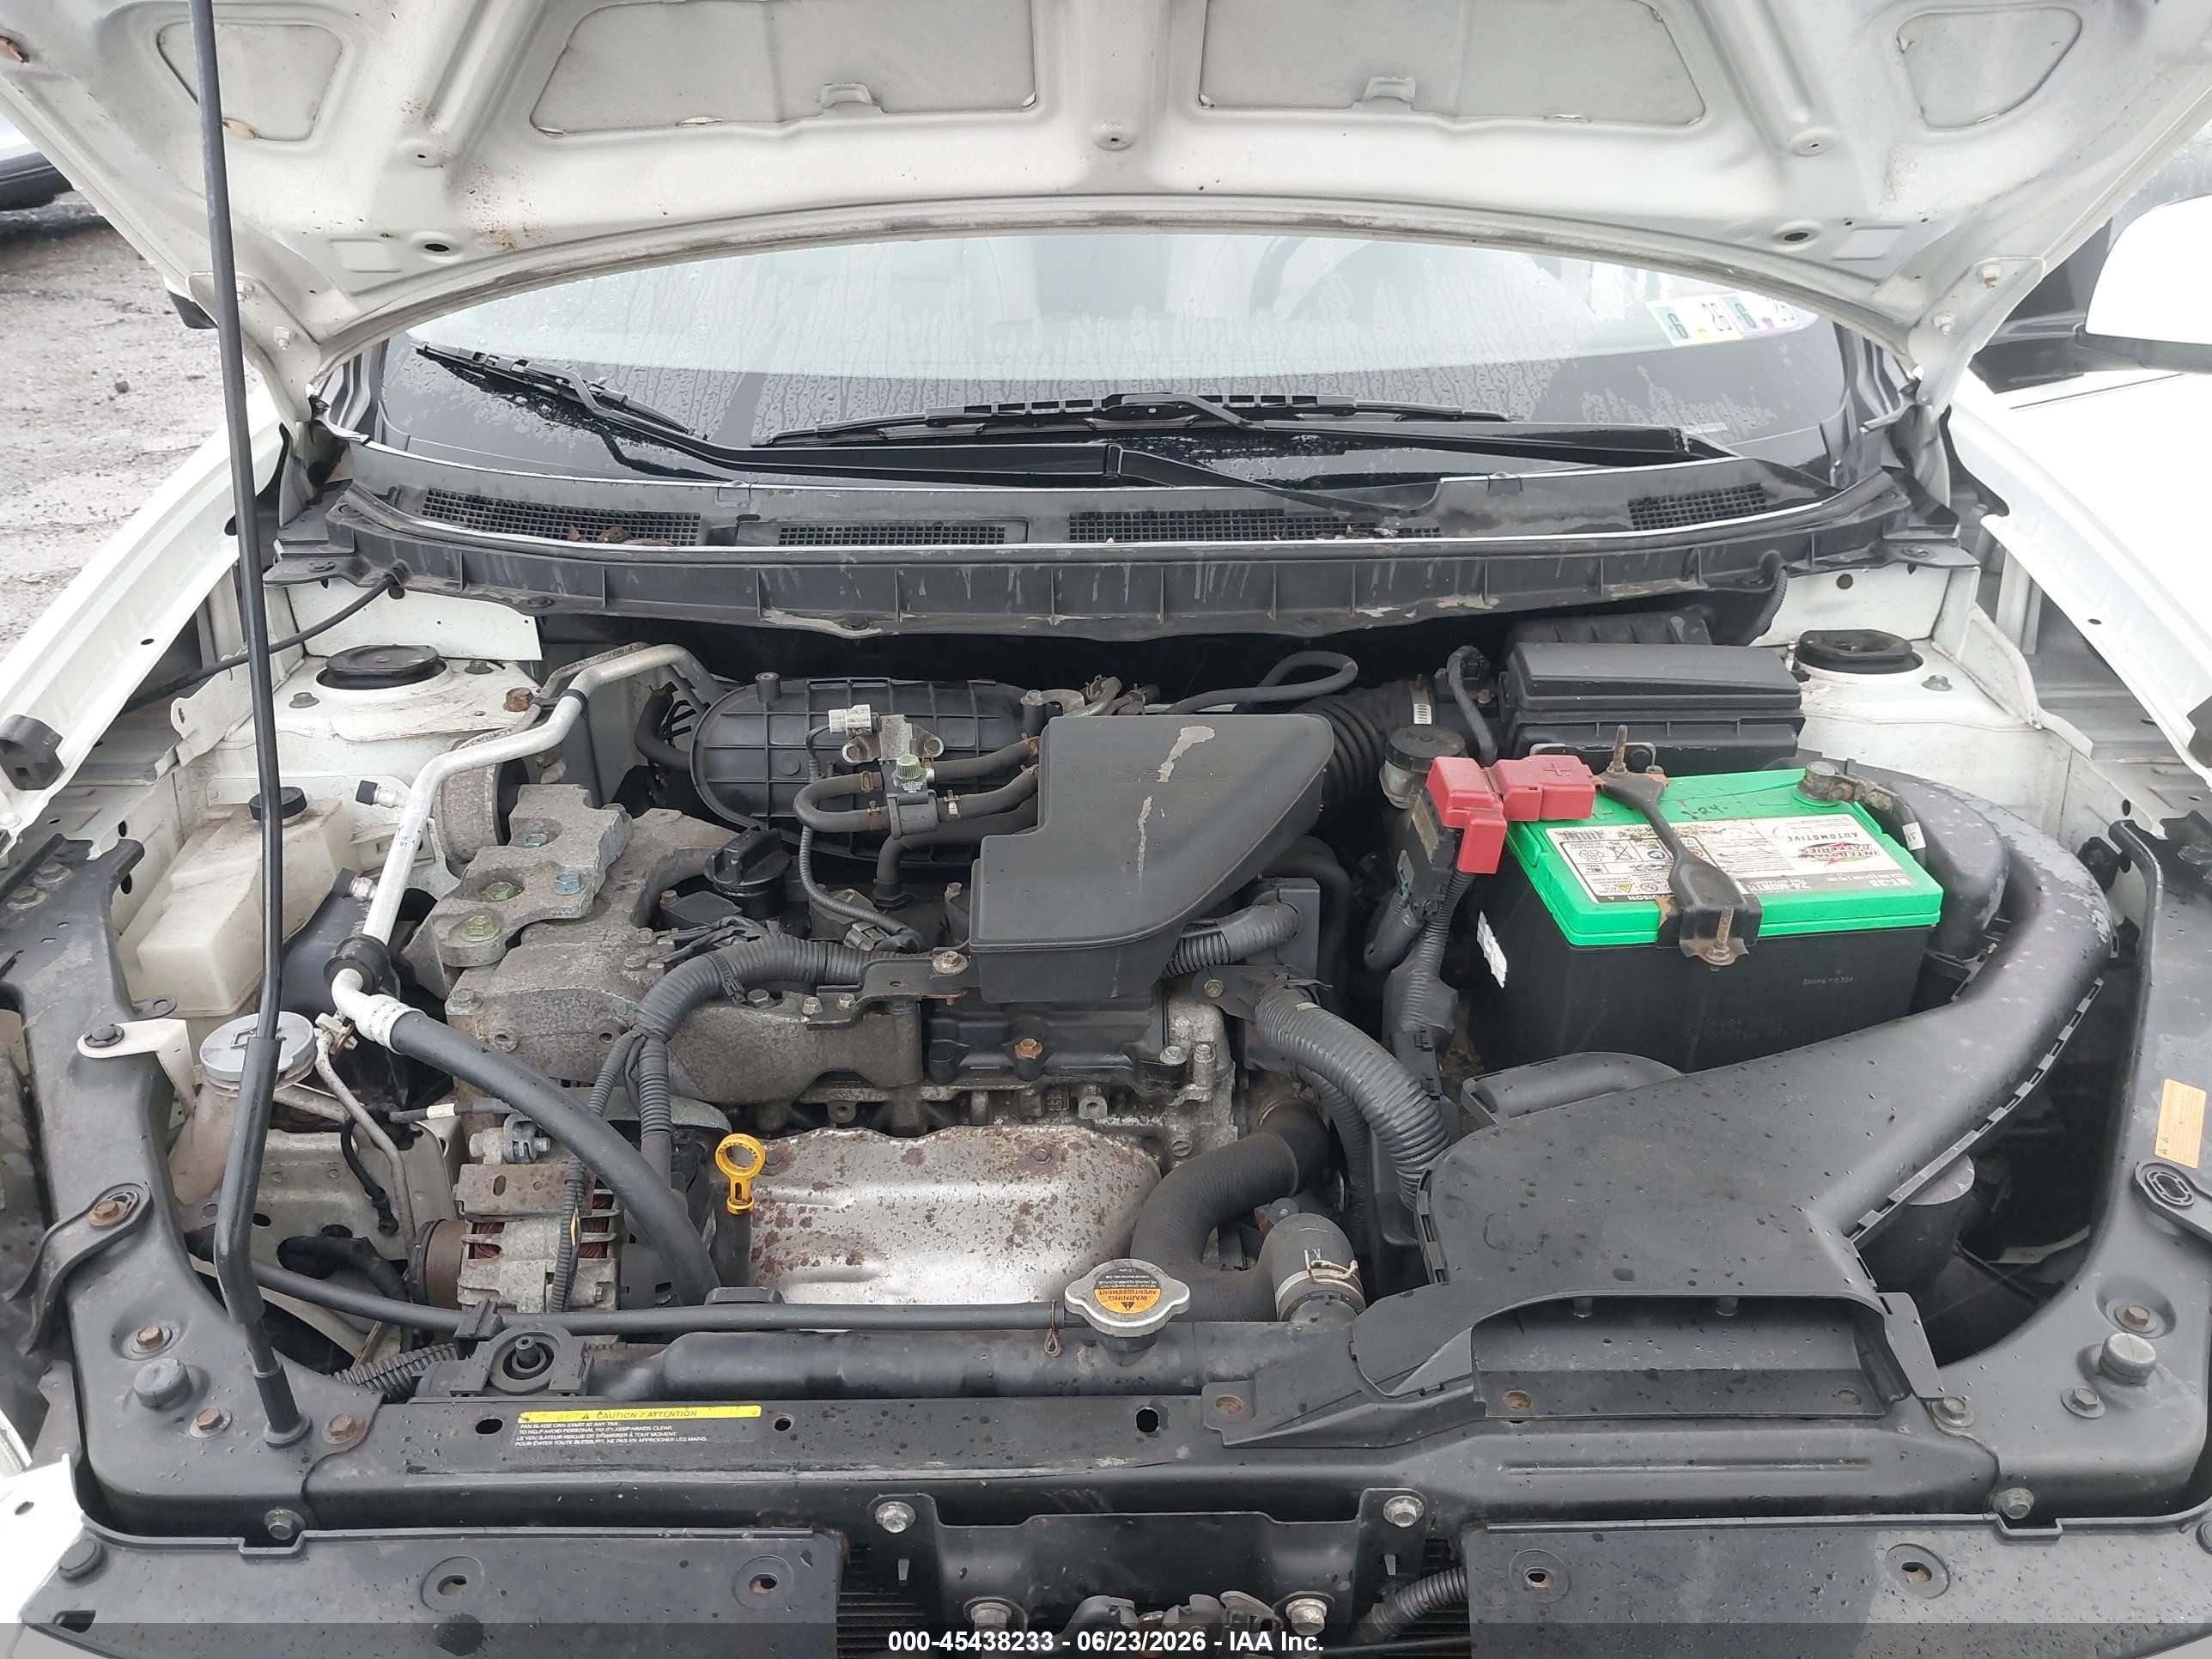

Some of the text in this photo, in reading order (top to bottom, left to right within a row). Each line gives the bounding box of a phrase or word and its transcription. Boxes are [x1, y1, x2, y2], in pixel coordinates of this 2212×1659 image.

[1667, 313, 1689, 339] 6
[1735, 302, 1758, 329] 6
[596, 1411, 637, 1419] CAUTION
[647, 1409, 697, 1419] ATTENTION
